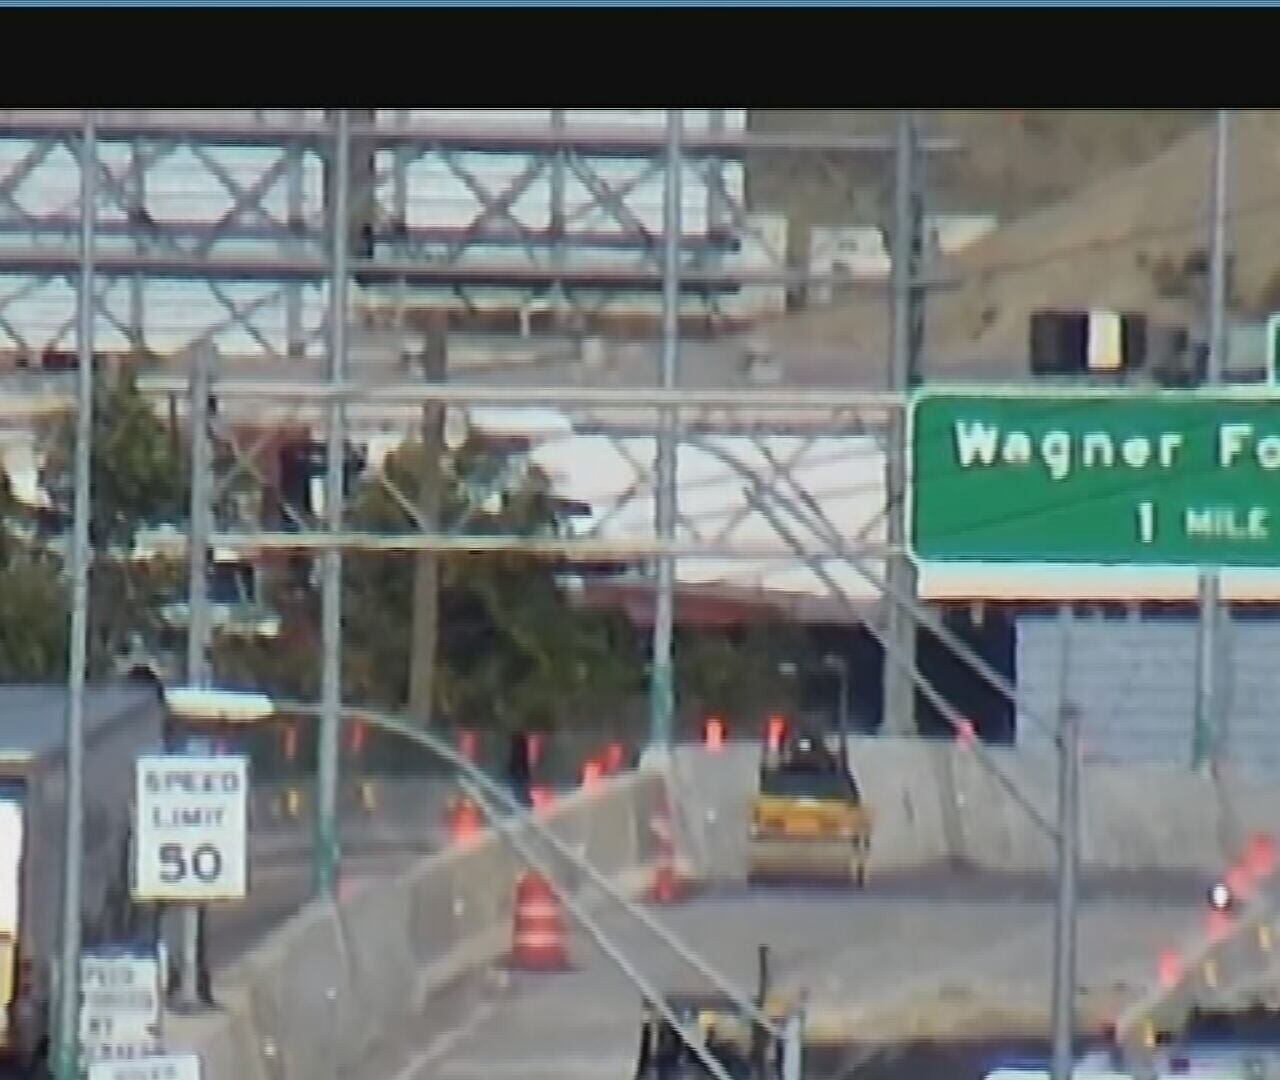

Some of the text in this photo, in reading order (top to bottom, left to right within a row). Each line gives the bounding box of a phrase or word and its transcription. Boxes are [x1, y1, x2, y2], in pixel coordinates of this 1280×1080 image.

[954, 420, 1183, 481] Wagner
[1138, 501, 1270, 543] 1 MILE
[144, 770, 240, 794] SPEED
[152, 806, 225, 830] LIMIT
[159, 842, 222, 883] 50
